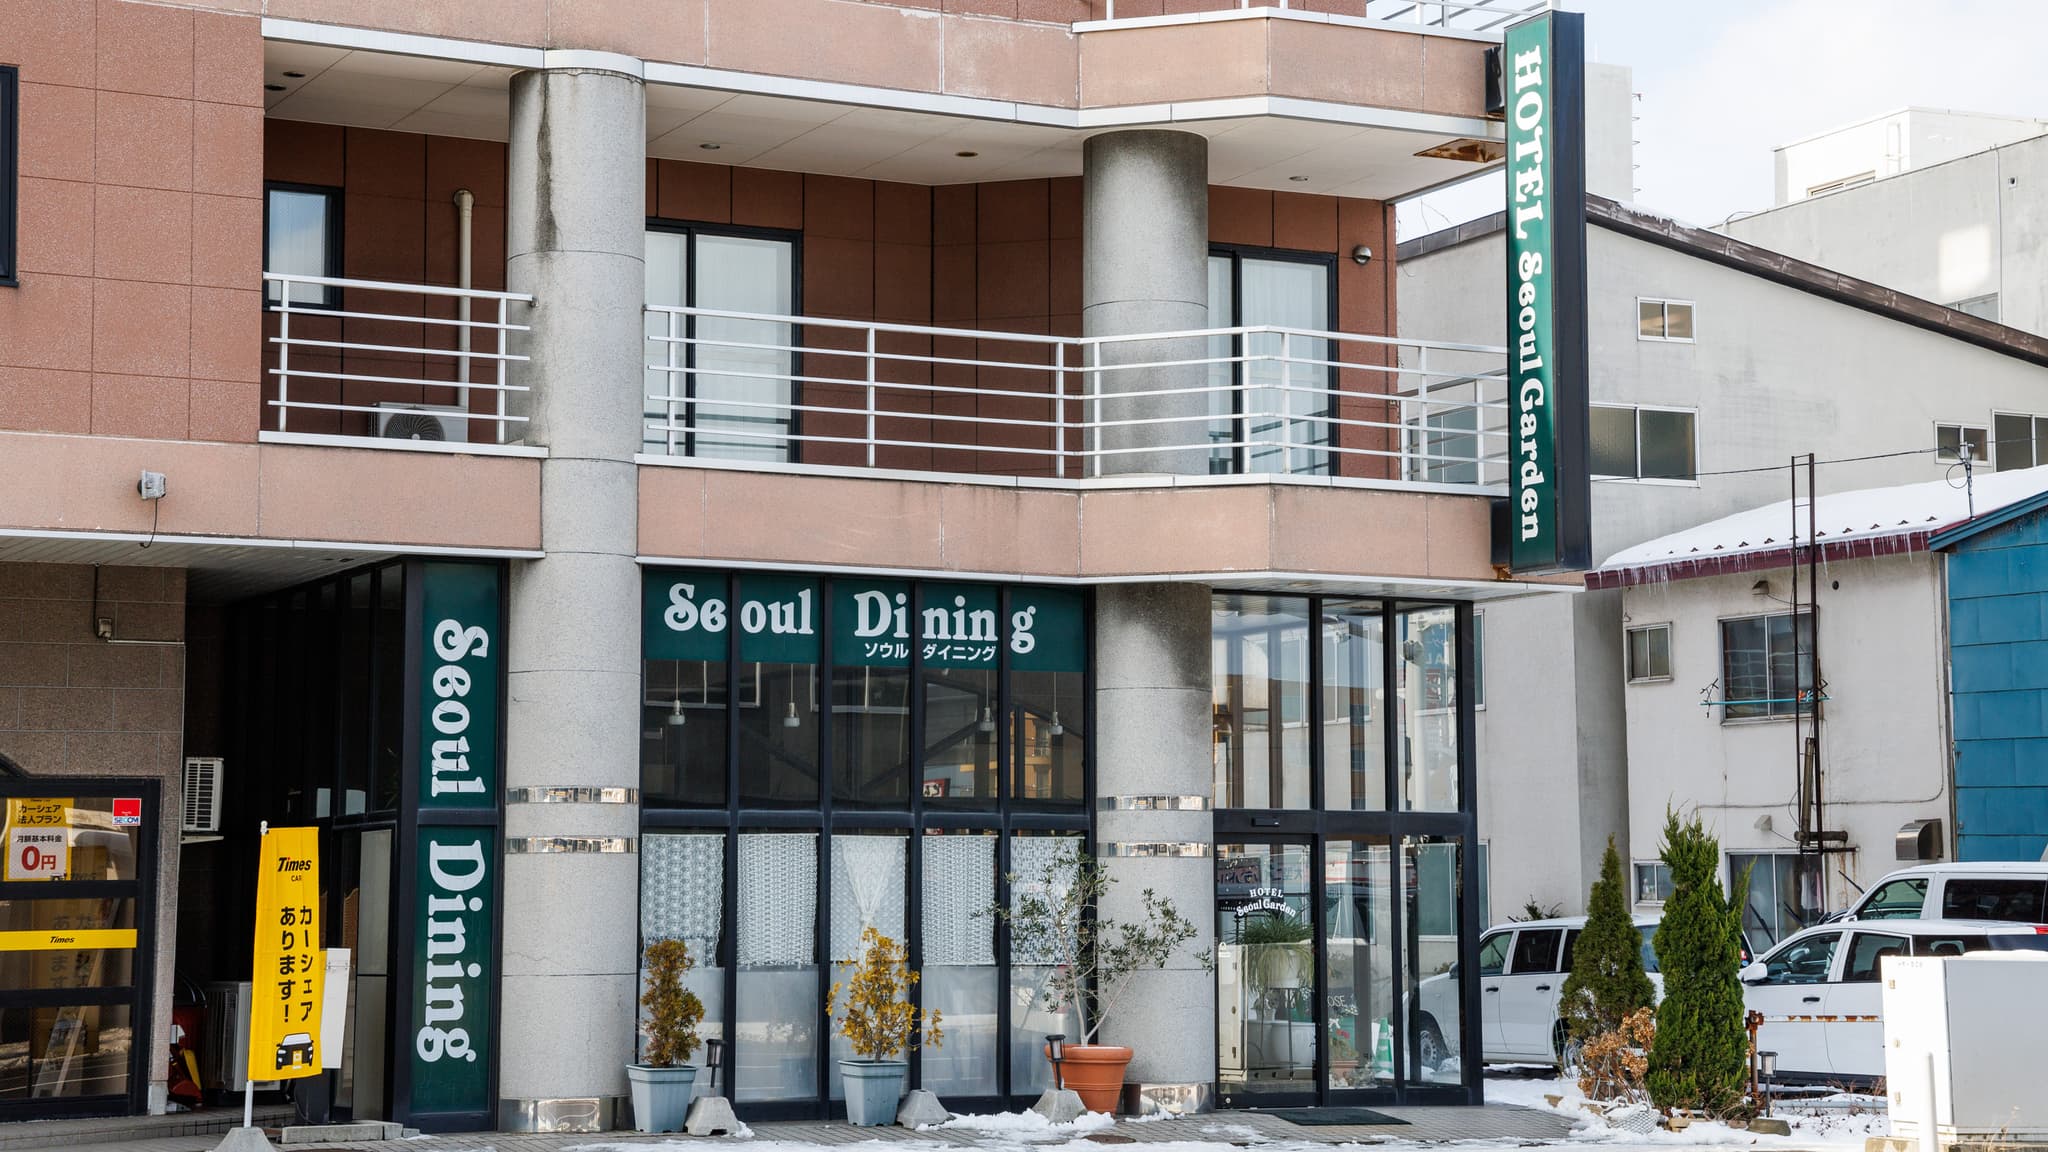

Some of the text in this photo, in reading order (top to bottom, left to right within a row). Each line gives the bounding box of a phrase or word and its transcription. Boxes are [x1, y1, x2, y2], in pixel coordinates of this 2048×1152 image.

[1514, 44, 1545, 542] HOTEL Seoul Garden
[663, 582, 1037, 654] Seoul Dining
[19, 804, 62, 814] カーシェア
[416, 618, 489, 1063] Seoul Dining
[21, 845, 57, 871] 0円
[277, 857, 312, 872] Times
[1249, 888, 1284, 898] HOTEL
[1236, 898, 1297, 917] Seoul Garden
[50, 936, 76, 944] Times
[278, 905, 297, 1024] あります！
[299, 905, 314, 1023] カーシェア
